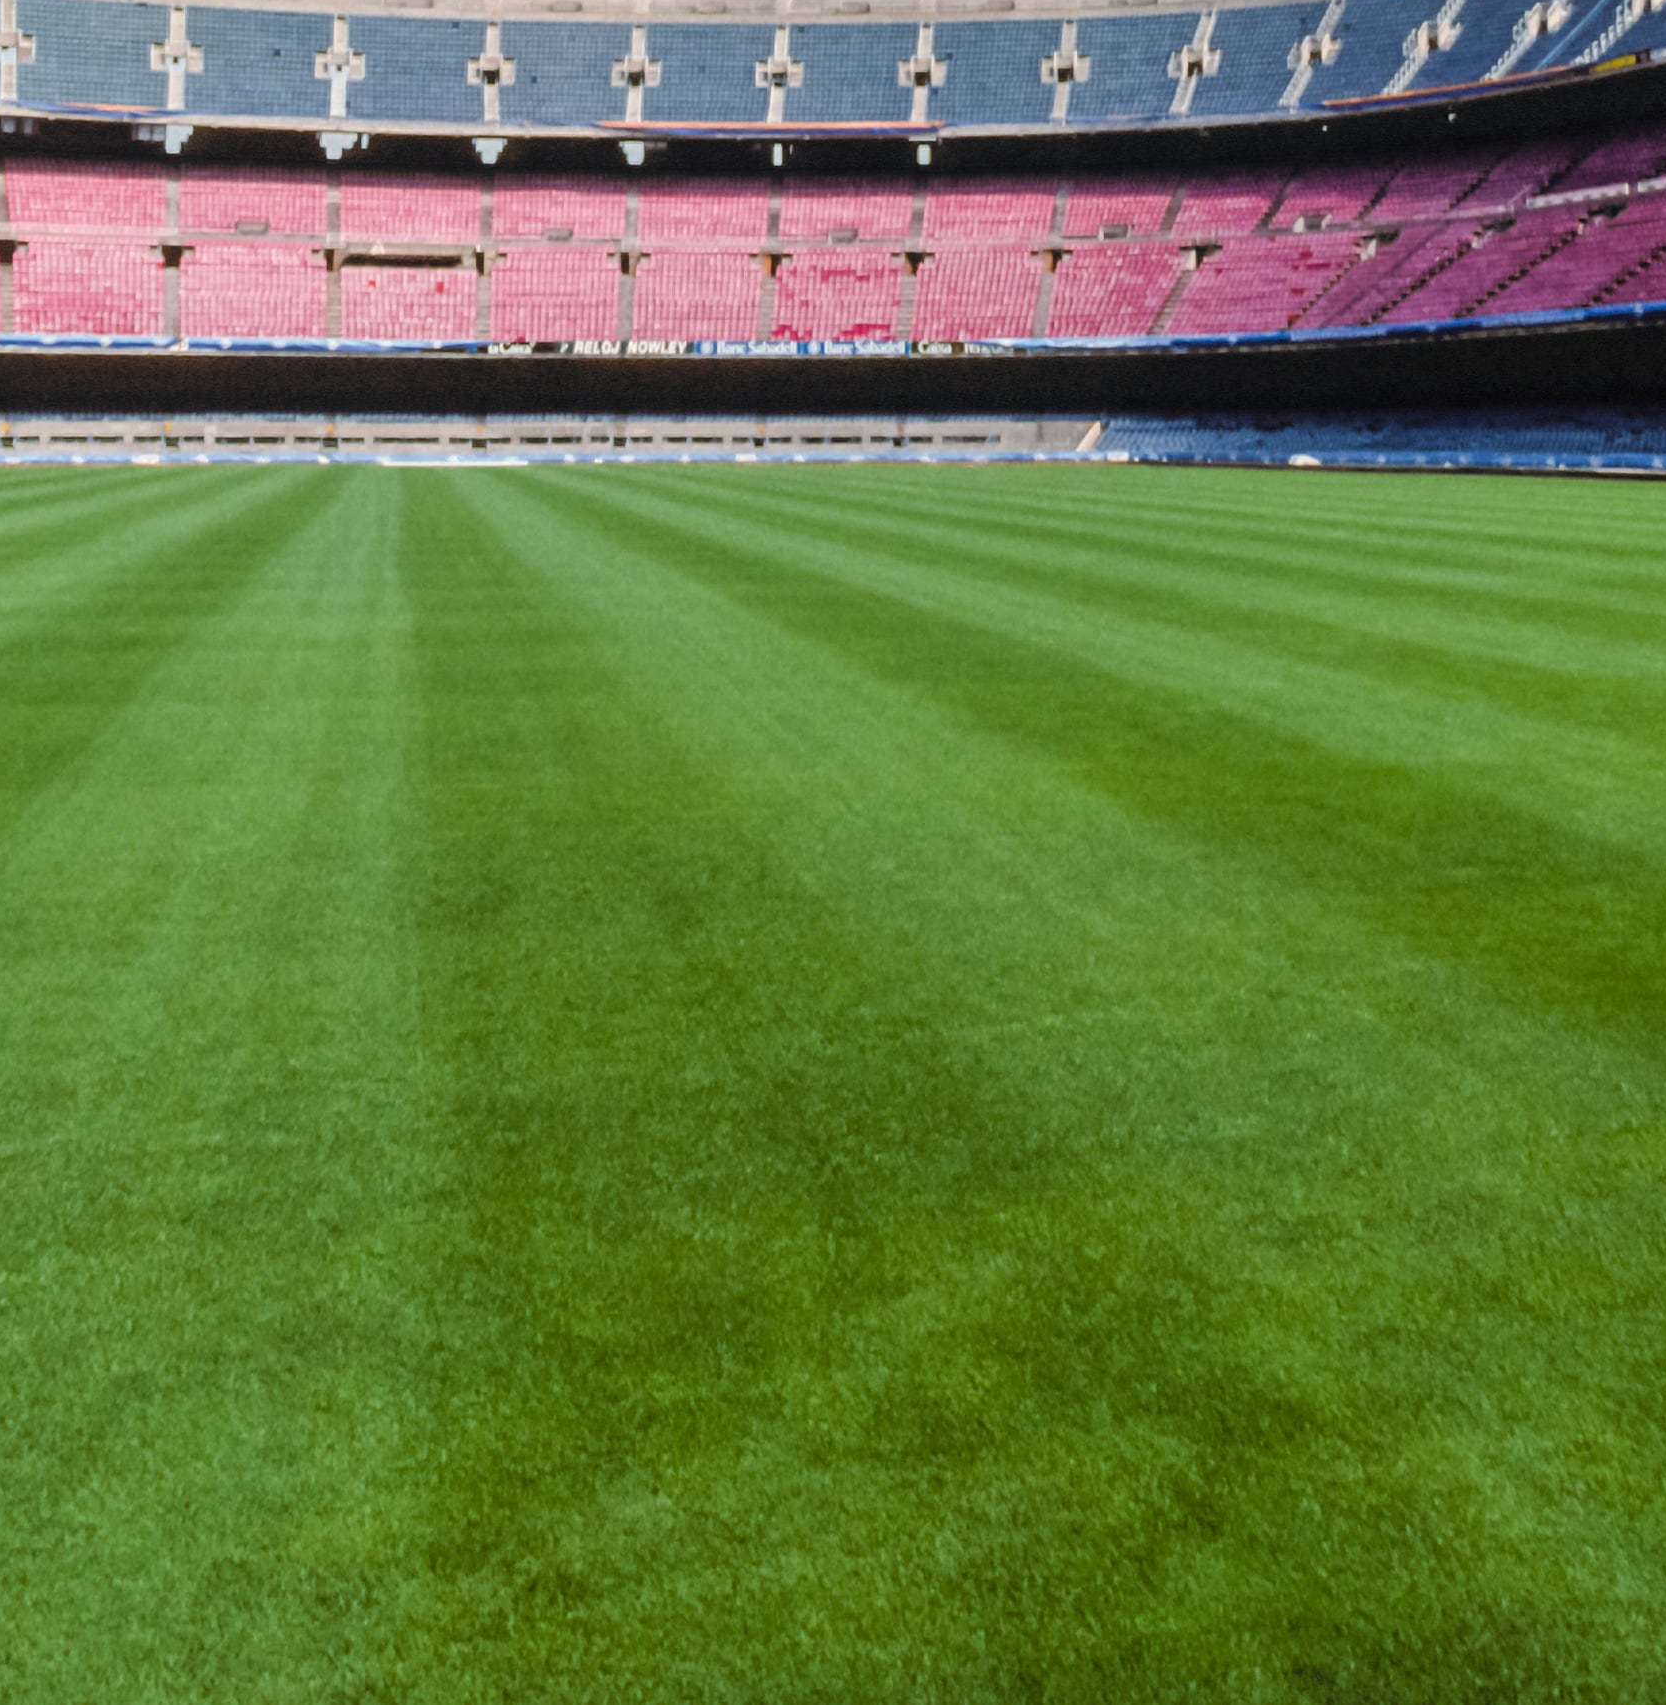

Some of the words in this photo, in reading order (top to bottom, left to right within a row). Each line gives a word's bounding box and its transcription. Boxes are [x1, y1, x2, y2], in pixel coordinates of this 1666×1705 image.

[573, 340, 620, 354] RELOJ
[626, 340, 687, 354] NOWLEY
[717, 340, 747, 354] Banc
[748, 340, 797, 354] Sabadell
[824, 340, 853, 354] Banc
[854, 340, 905, 354] Sabadell
